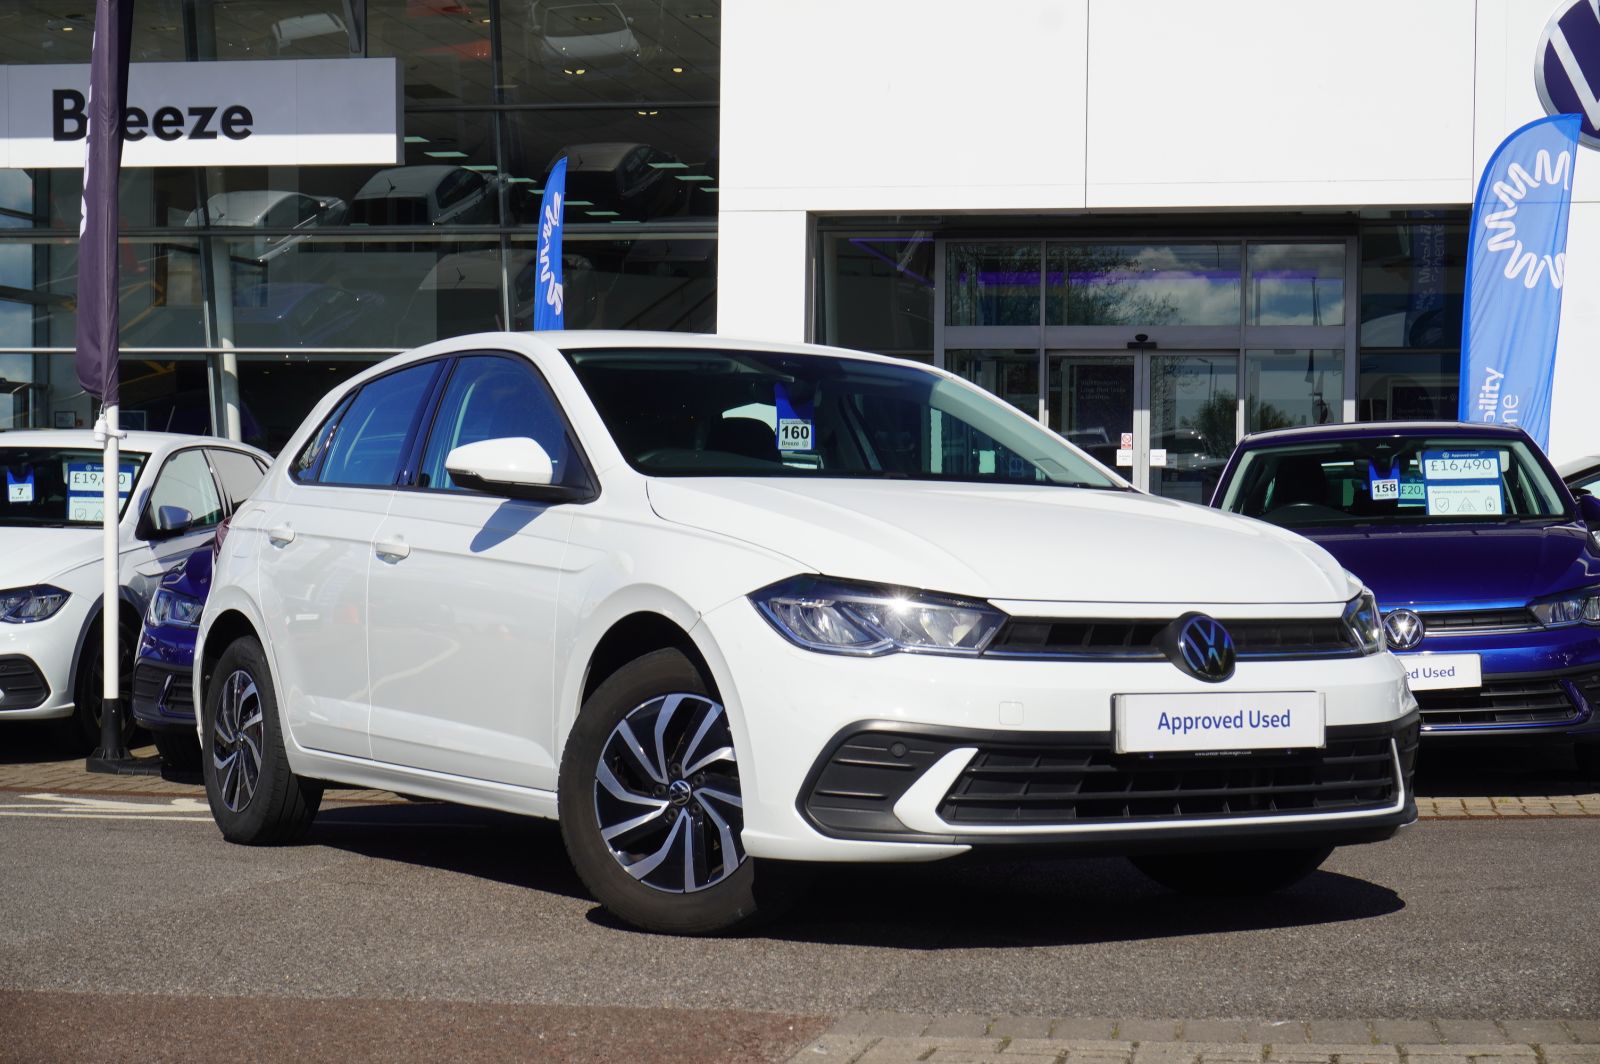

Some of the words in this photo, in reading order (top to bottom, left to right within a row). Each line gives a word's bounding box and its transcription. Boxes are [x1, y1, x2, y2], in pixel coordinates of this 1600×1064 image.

[53, 88, 253, 141] Beeze
[782, 425, 809, 440] 160
[1431, 458, 1492, 473] £16,490
[74, 472, 126, 486] £19,0
[17, 488, 24, 496] 7
[1374, 483, 1397, 493] 158
[1422, 666, 1455, 678] Used
[1158, 709, 1243, 735] Approved
[1248, 708, 1291, 728] Used
